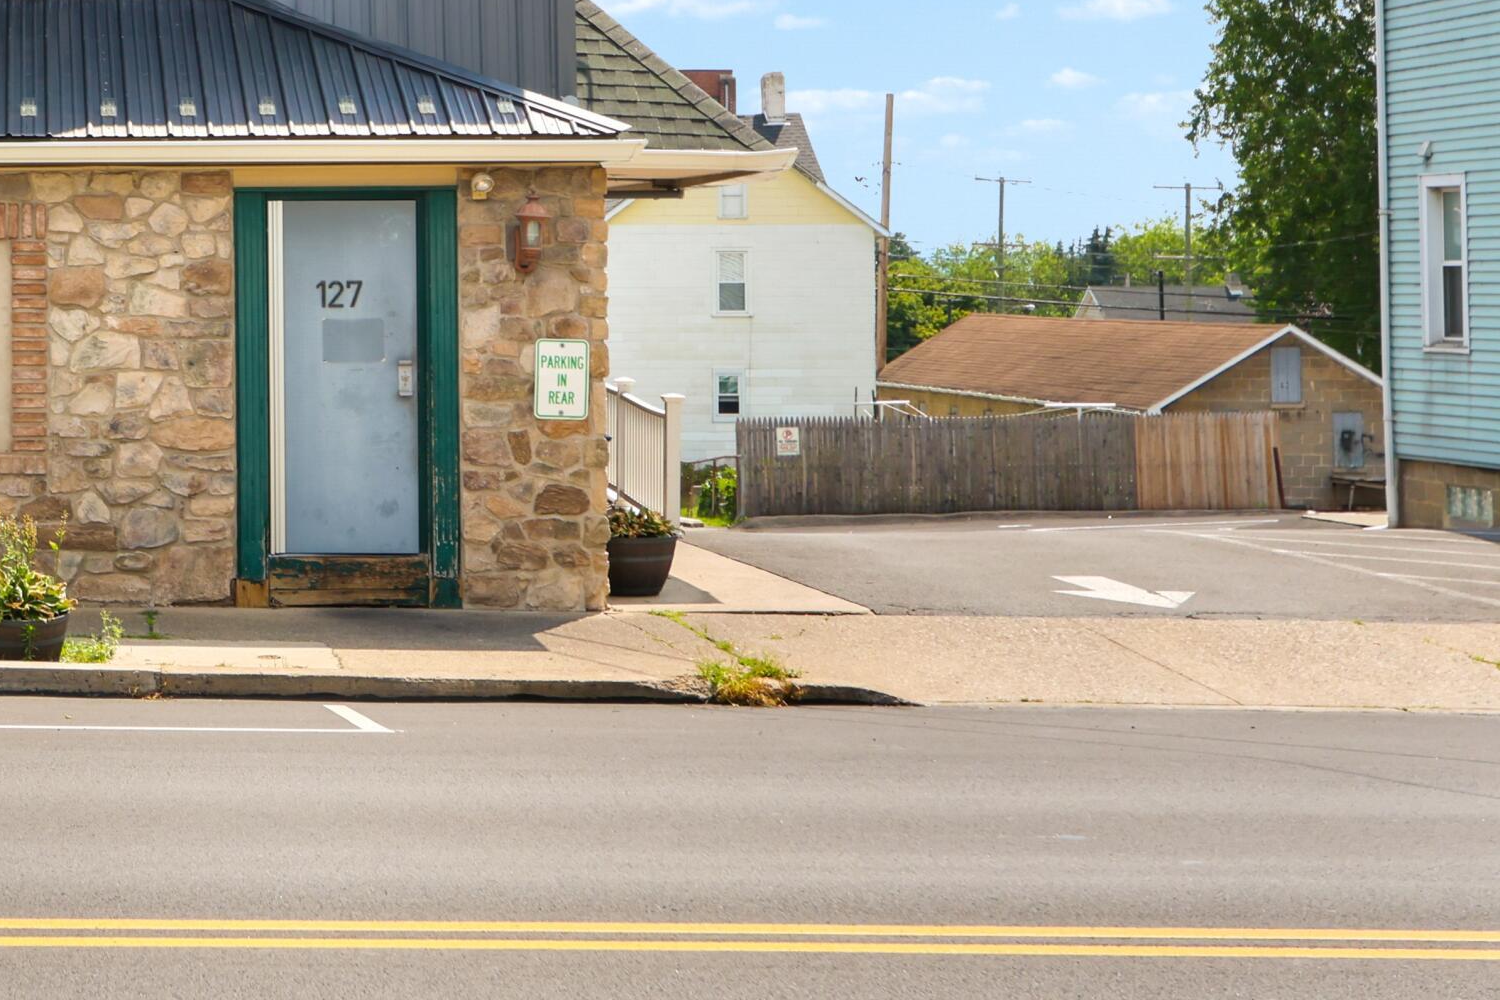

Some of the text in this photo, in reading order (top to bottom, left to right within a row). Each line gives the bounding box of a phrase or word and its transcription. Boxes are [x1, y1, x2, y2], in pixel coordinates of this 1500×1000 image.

[316, 280, 363, 309] 127
[540, 355, 584, 370] PARKING
[557, 373, 567, 387] IN
[548, 390, 575, 405] REAR
